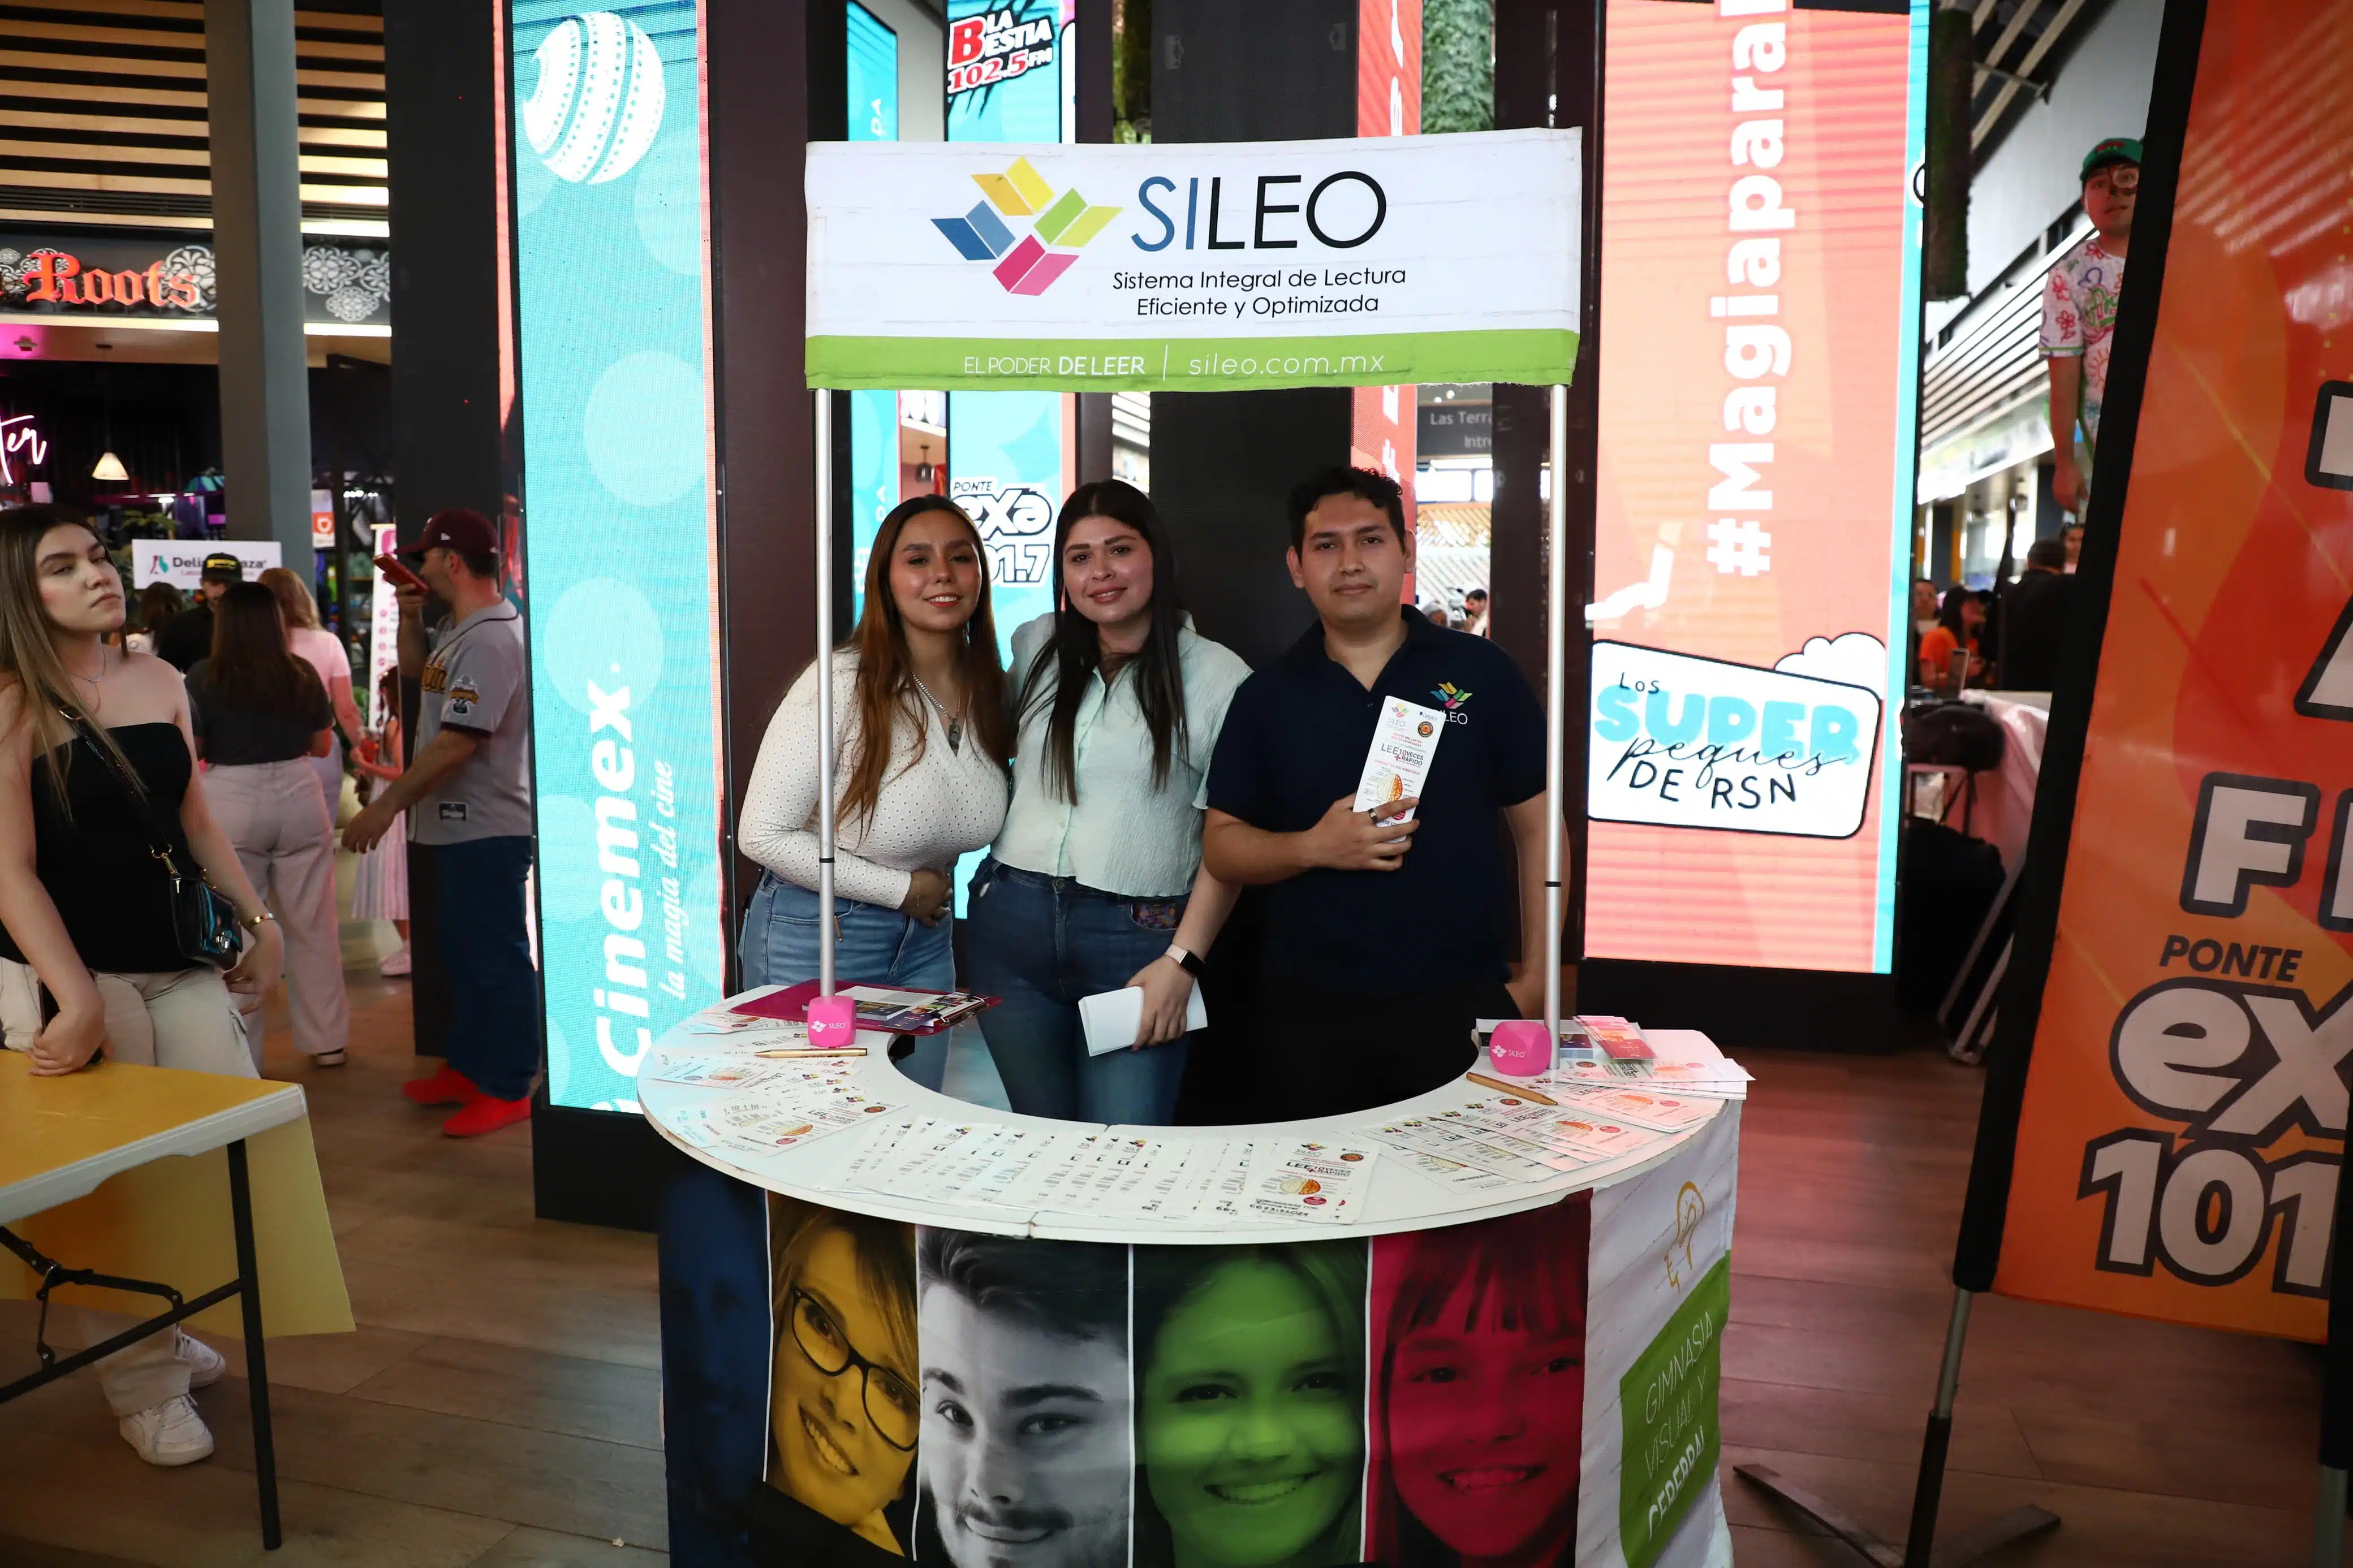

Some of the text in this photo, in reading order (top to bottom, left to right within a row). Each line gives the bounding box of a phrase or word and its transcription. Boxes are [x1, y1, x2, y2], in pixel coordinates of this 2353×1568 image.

[947, 16, 1053, 70] BESTIA
[986, 10, 1014, 34] LA
[947, 49, 1029, 94] 102.5
[1131, 171, 1386, 252] SILEO
[23, 250, 200, 308] Roots
[1113, 267, 1406, 292] Sistema Integral de Lectura
[1137, 295, 1379, 318] Eficiente y Optimizada
[964, 356, 1145, 375] EL PODER DE LEER
[1188, 352, 1385, 376] sileo.com.mx
[1430, 412, 1454, 426] Las
[954, 481, 993, 492] PONTE
[1594, 684, 1860, 764] SUPER
[1381, 742, 1400, 755] LEE
[1606, 737, 1855, 789] peques
[1629, 761, 1796, 809] DE RSN
[588, 679, 651, 1077] Cinemex
[649, 759, 689, 1000] la magia del cine
[2160, 934, 2303, 984] PONTE
[1508, 1049, 1525, 1058] SILEO
[1646, 1311, 1713, 1424] GIMNASIA
[1697, 1366, 1706, 1405] Y
